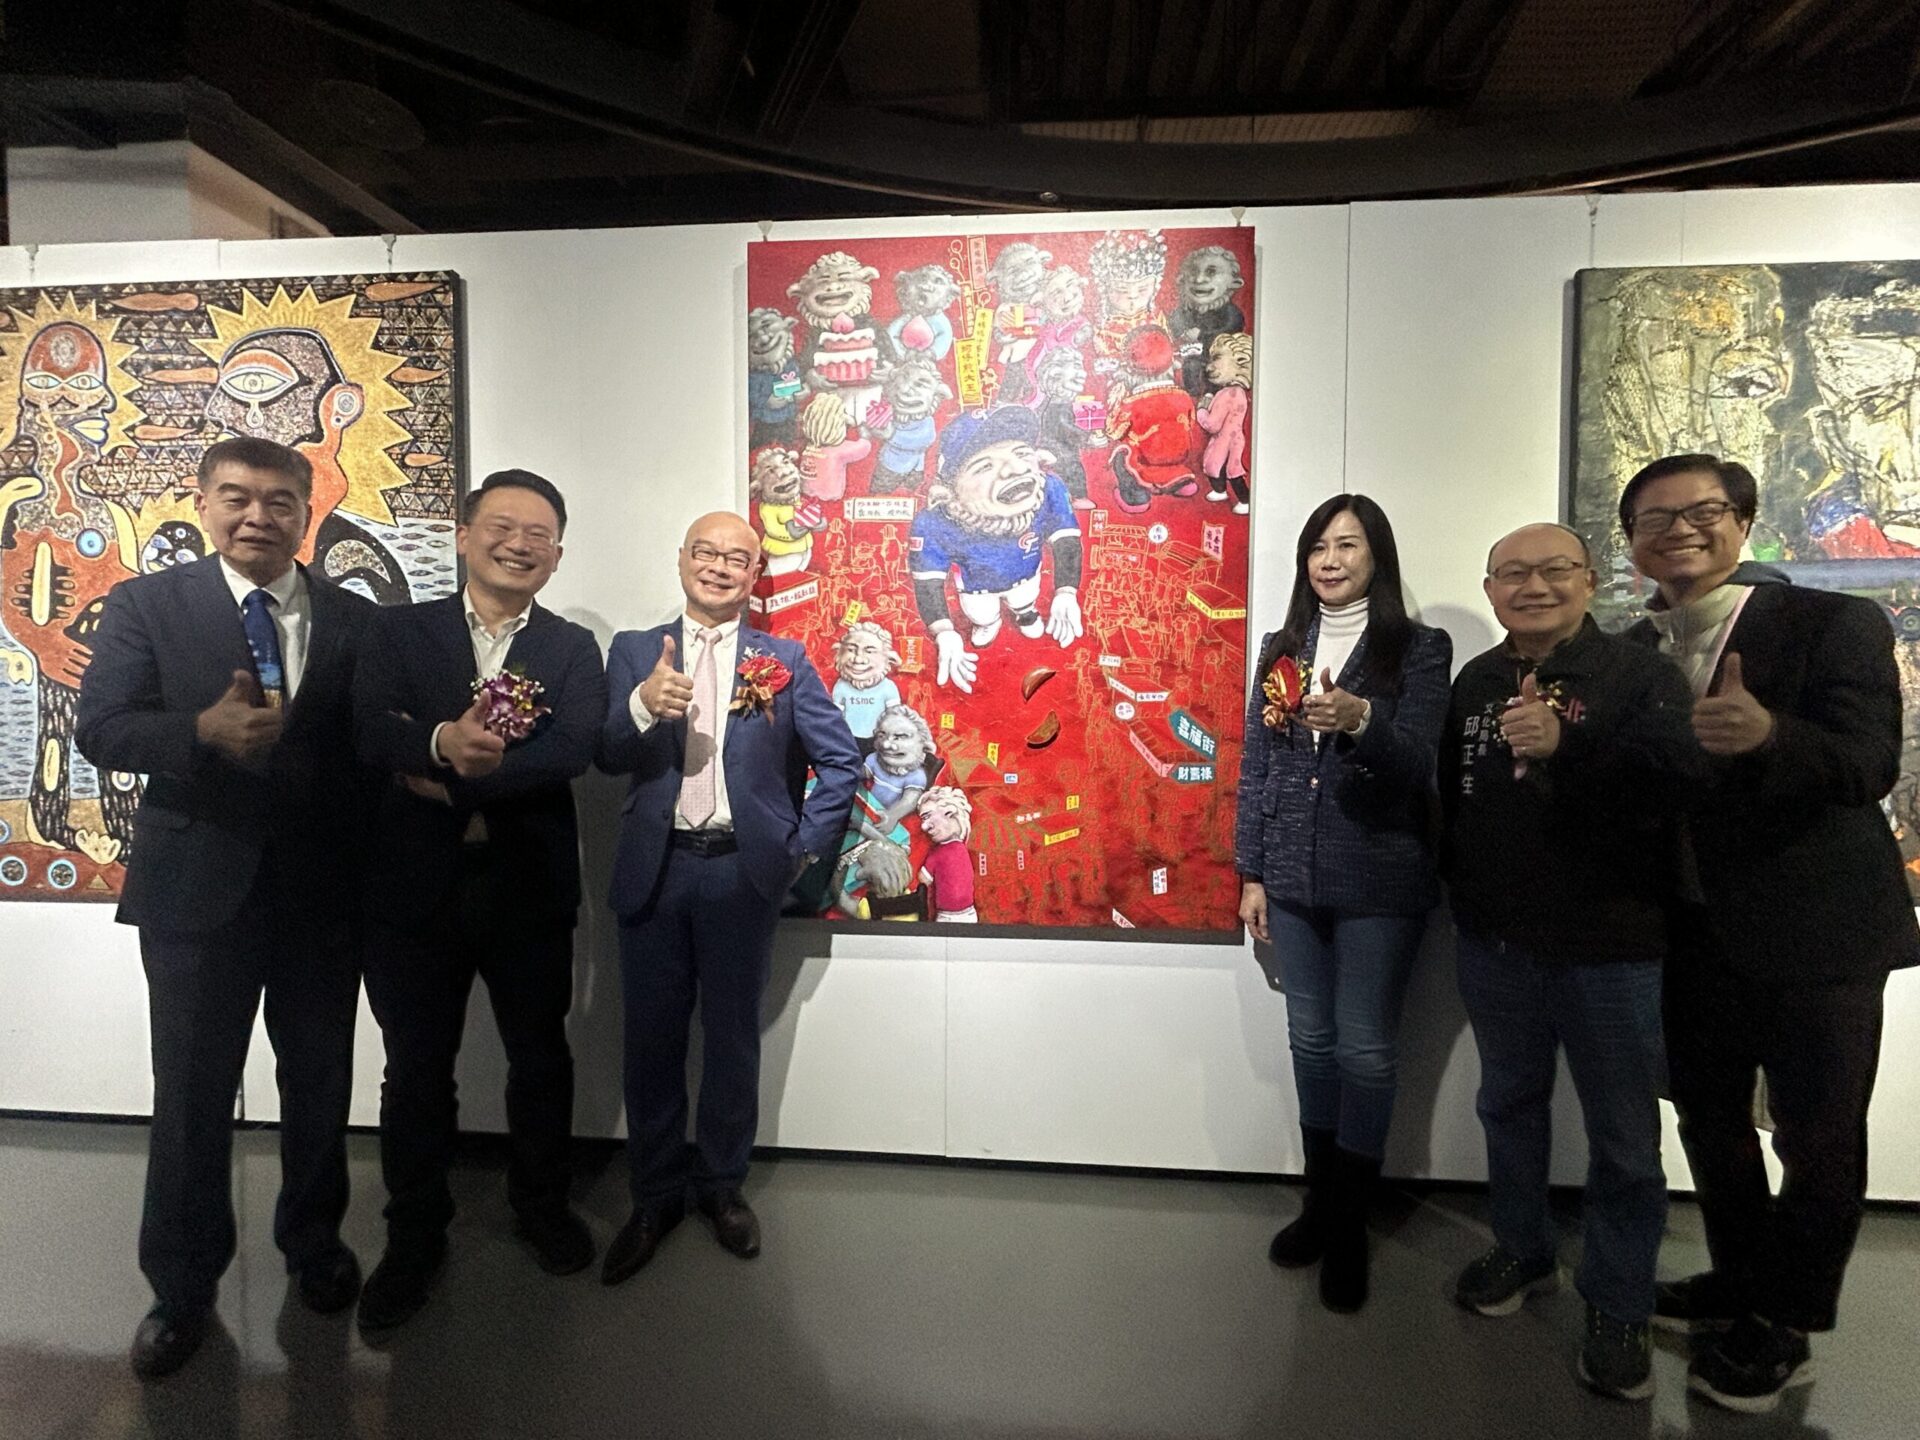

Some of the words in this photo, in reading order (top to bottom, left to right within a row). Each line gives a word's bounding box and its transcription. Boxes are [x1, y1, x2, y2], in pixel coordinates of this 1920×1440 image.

[850, 696, 875, 705] tsmc
[1462, 716, 1481, 794] 邱正生
